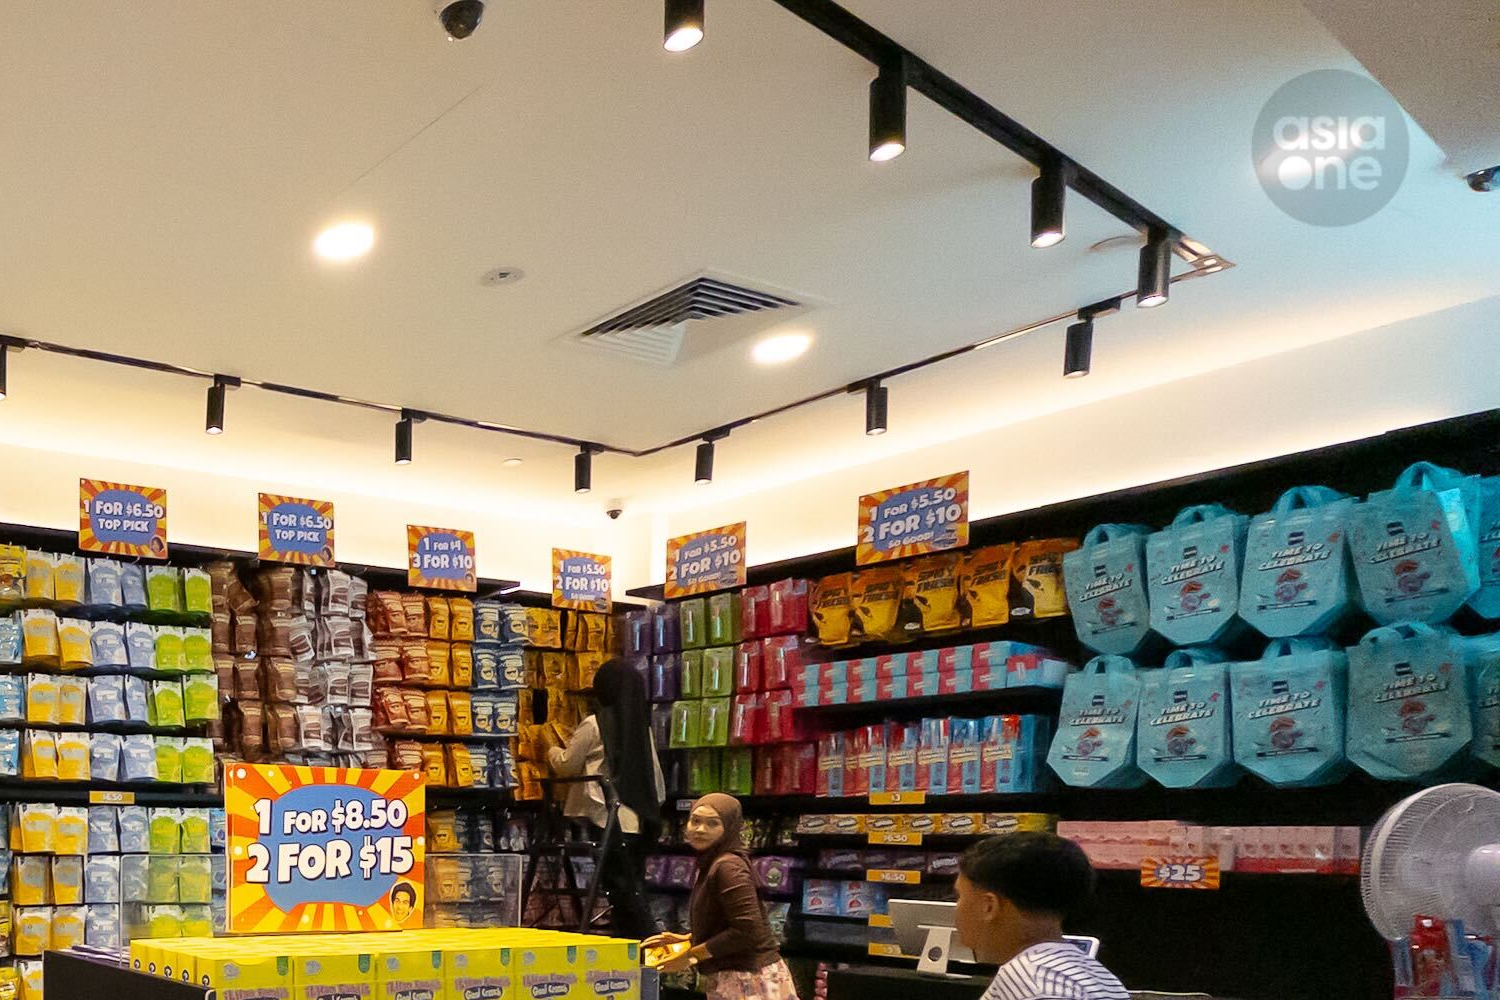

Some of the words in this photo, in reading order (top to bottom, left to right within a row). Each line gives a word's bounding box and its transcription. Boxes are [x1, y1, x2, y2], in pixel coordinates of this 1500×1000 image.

[83, 499, 90, 513] 1
[95, 500, 123, 515] FOR
[125, 502, 164, 519] $6.50
[869, 506, 878, 521] 1
[883, 503, 908, 518] FOR
[911, 487, 957, 511] $5.50
[98, 518, 122, 531] TOP
[123, 520, 150, 532] PICK
[262, 511, 268, 524] 1
[272, 512, 297, 527] FOR
[299, 514, 333, 530] $6.50
[862, 526, 875, 543] 2
[879, 514, 921, 540] FOR
[926, 504, 962, 529] $10
[275, 529, 296, 541] TOP
[297, 530, 320, 542] PICK
[423, 537, 430, 550] 1
[433, 542, 449, 551] FOR
[674, 549, 680, 562] 1
[703, 535, 738, 553] $5.50
[412, 552, 421, 568] 3
[423, 554, 450, 569] FOR
[452, 554, 473, 569] $10
[560, 560, 564, 573] 1
[667, 566, 677, 580] 2
[681, 557, 712, 578] FOR
[714, 549, 742, 569] $10
[1170, 561, 1197, 574] TIME
[556, 575, 563, 589] 2
[565, 577, 589, 590] FOR
[590, 577, 609, 592] $10
[1150, 708, 1214, 727] CELEBRATE
[1160, 705, 1187, 715] TIME
[253, 798, 272, 836] 1
[284, 808, 327, 835] FOR
[331, 798, 408, 833] $8.50
[245, 842, 271, 884] 2
[277, 838, 353, 883] FOR
[359, 835, 415, 879] $15
[1157, 864, 1202, 882] $25
